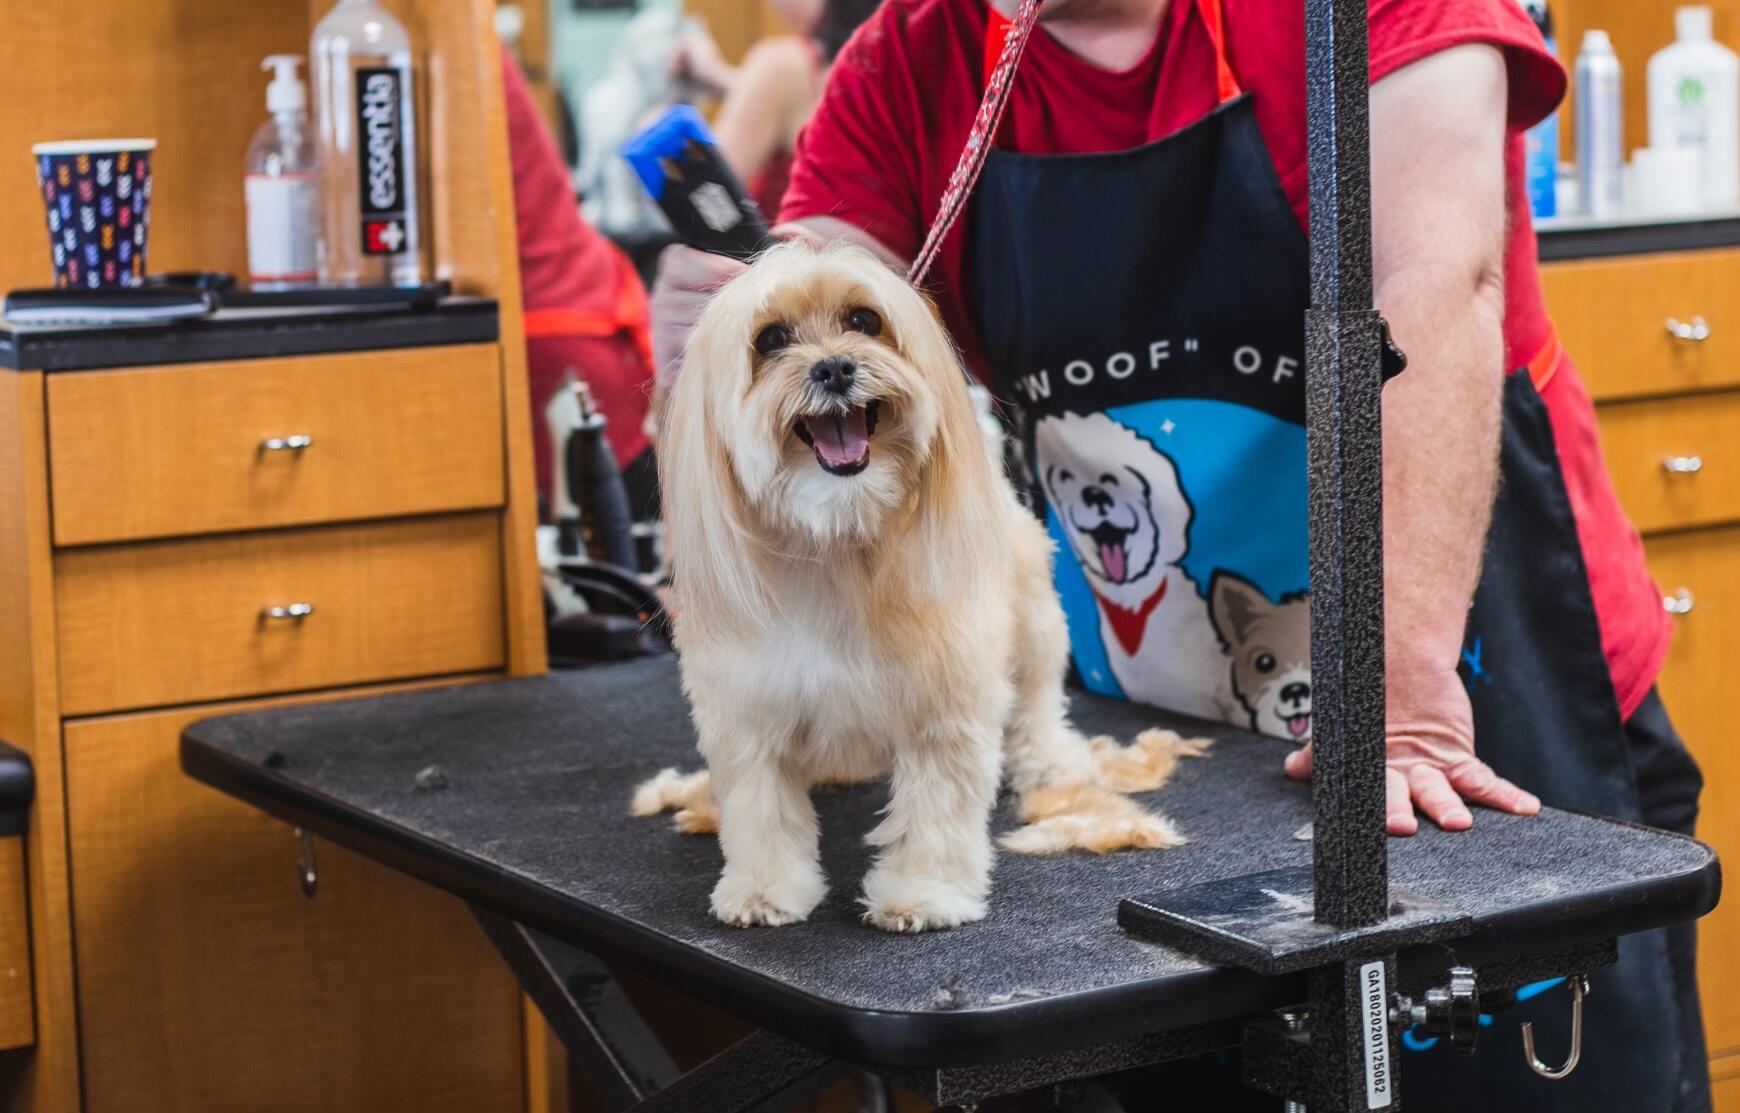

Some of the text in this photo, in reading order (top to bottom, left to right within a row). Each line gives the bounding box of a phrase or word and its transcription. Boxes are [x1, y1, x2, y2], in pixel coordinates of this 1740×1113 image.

[362, 73, 396, 209] essentia
[1233, 345, 1298, 383] OF
[1367, 969, 1386, 1094] GA18020201125062
